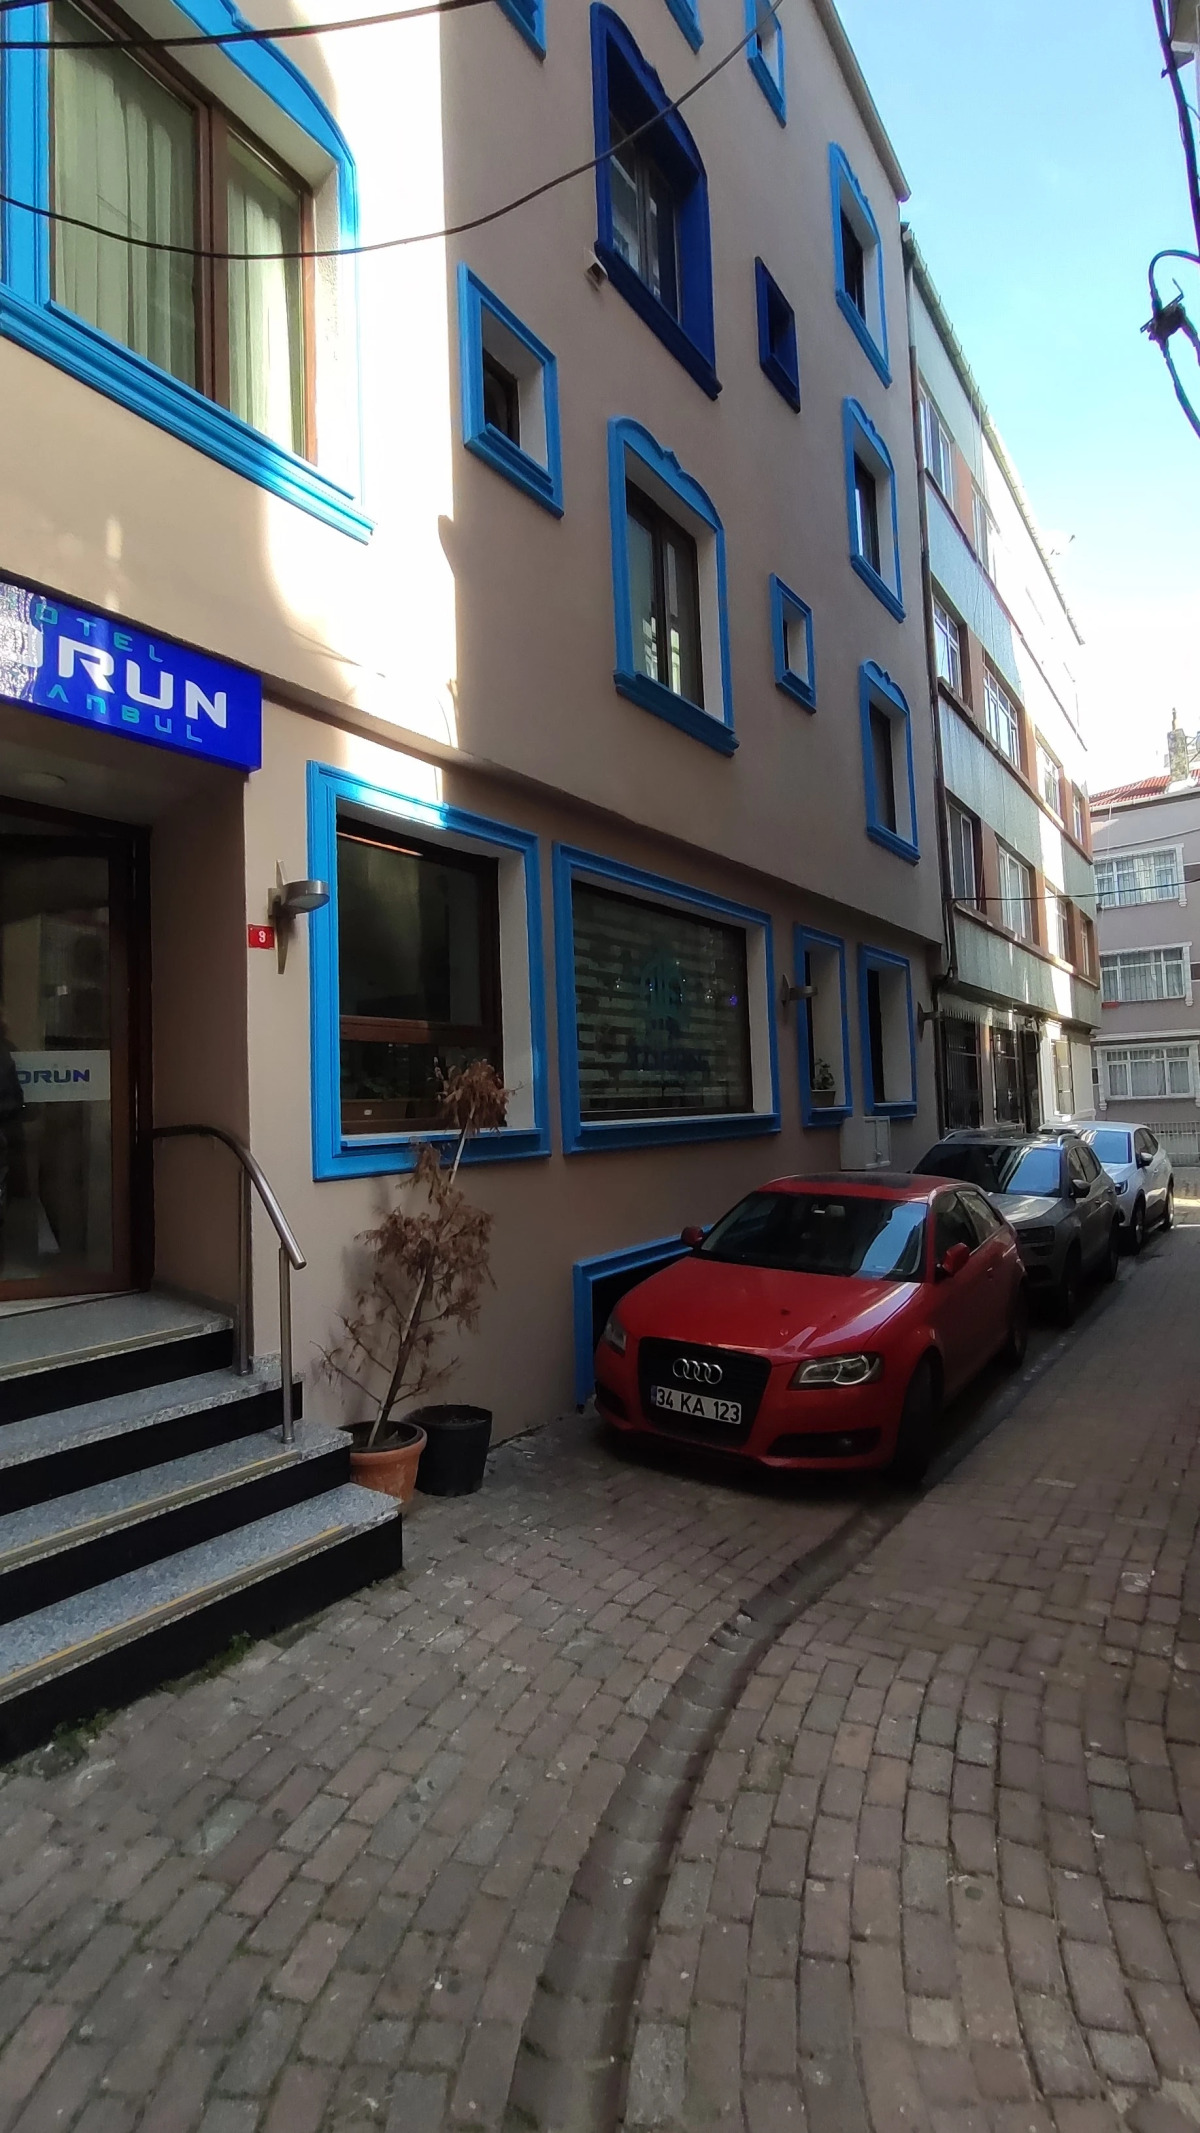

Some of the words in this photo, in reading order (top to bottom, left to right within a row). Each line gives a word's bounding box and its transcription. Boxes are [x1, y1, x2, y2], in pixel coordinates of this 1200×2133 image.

[10, 592, 163, 663] OTEL
[12, 670, 203, 744] ANBUL
[258, 930, 267, 943] 9
[657, 1388, 674, 1409] 34
[680, 1394, 705, 1416] KA
[713, 1400, 740, 1423] 123
